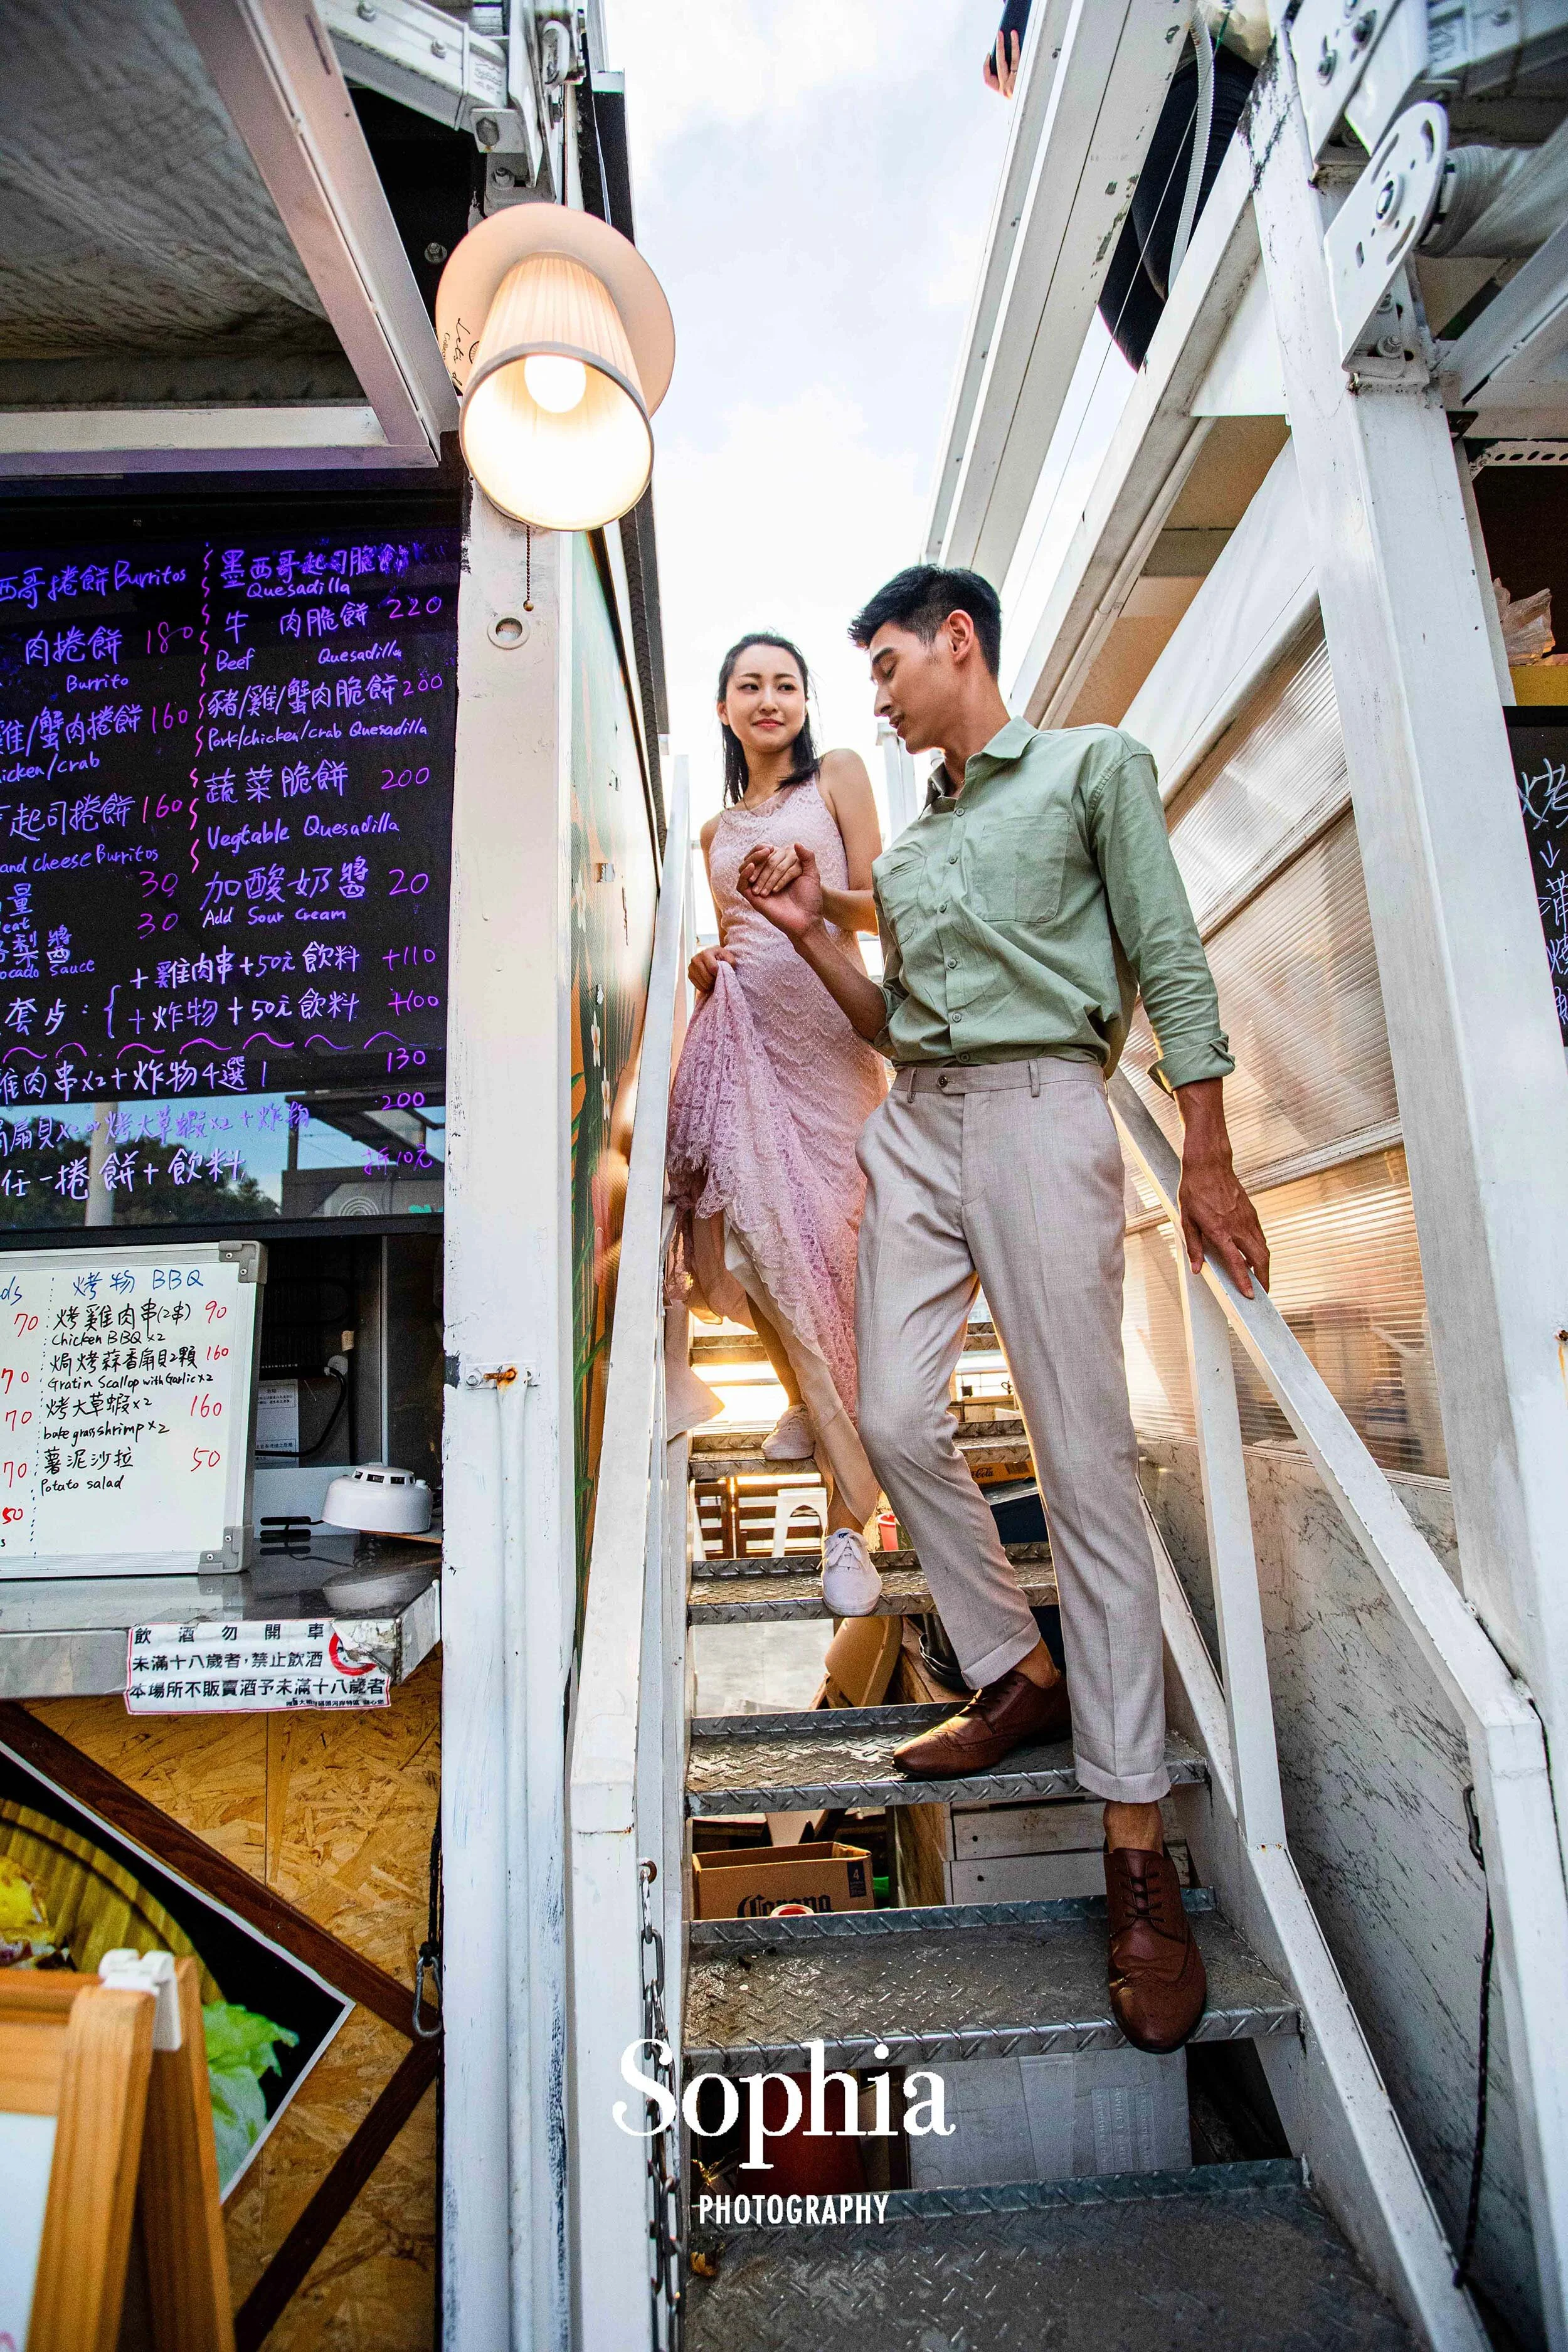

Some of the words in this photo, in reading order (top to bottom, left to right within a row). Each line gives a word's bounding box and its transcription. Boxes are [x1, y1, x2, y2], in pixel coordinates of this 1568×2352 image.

[114, 560, 186, 590] Burritos
[246, 578, 350, 598] Quesadilla
[387, 598, 442, 618] 220
[147, 622, 193, 654] 180
[216, 648, 255, 672] Beef
[318, 640, 403, 664] Quesadilla
[66, 674, 129, 692] Burrito
[403, 673, 443, 696] 200
[152, 702, 188, 734] 160
[349, 718, 428, 738] Quesadilla
[381, 767, 430, 790] 200
[0, 792, 136, 842] 起司捲餅
[142, 793, 183, 824] 160
[304, 812, 400, 838] Quesadilla
[95, 844, 159, 865] Burritos
[139, 871, 179, 901] 30
[388, 869, 429, 896] 20
[0, 918, 30, 934] eat
[137, 913, 179, 940] 30
[202, 908, 233, 928] Add
[248, 906, 284, 925] Sour
[386, 1047, 426, 1073] 130
[381, 1091, 425, 1111] 200
[152, 1269, 204, 1291] BBQ
[204, 1300, 227, 1324] 90
[14, 1313, 38, 1338] 70
[107, 1330, 142, 1345] BBQ
[206, 1345, 230, 1361] 160
[1, 1367, 29, 1394] 70
[48, 1376, 93, 1391] Gratin
[98, 1374, 140, 1394] Scallop
[142, 1375, 164, 1386] with
[190, 1394, 222, 1417] 160
[5, 1409, 32, 1431] 70
[43, 1446, 134, 1475] 薯泥沙拉
[190, 1447, 221, 1472] 50
[4, 1461, 28, 1488] 70
[86, 1475, 125, 1490] salad
[2, 1507, 23, 1525] 50
[129, 1677, 386, 1699] 本場所不販賣酒予未滿十八歲者
